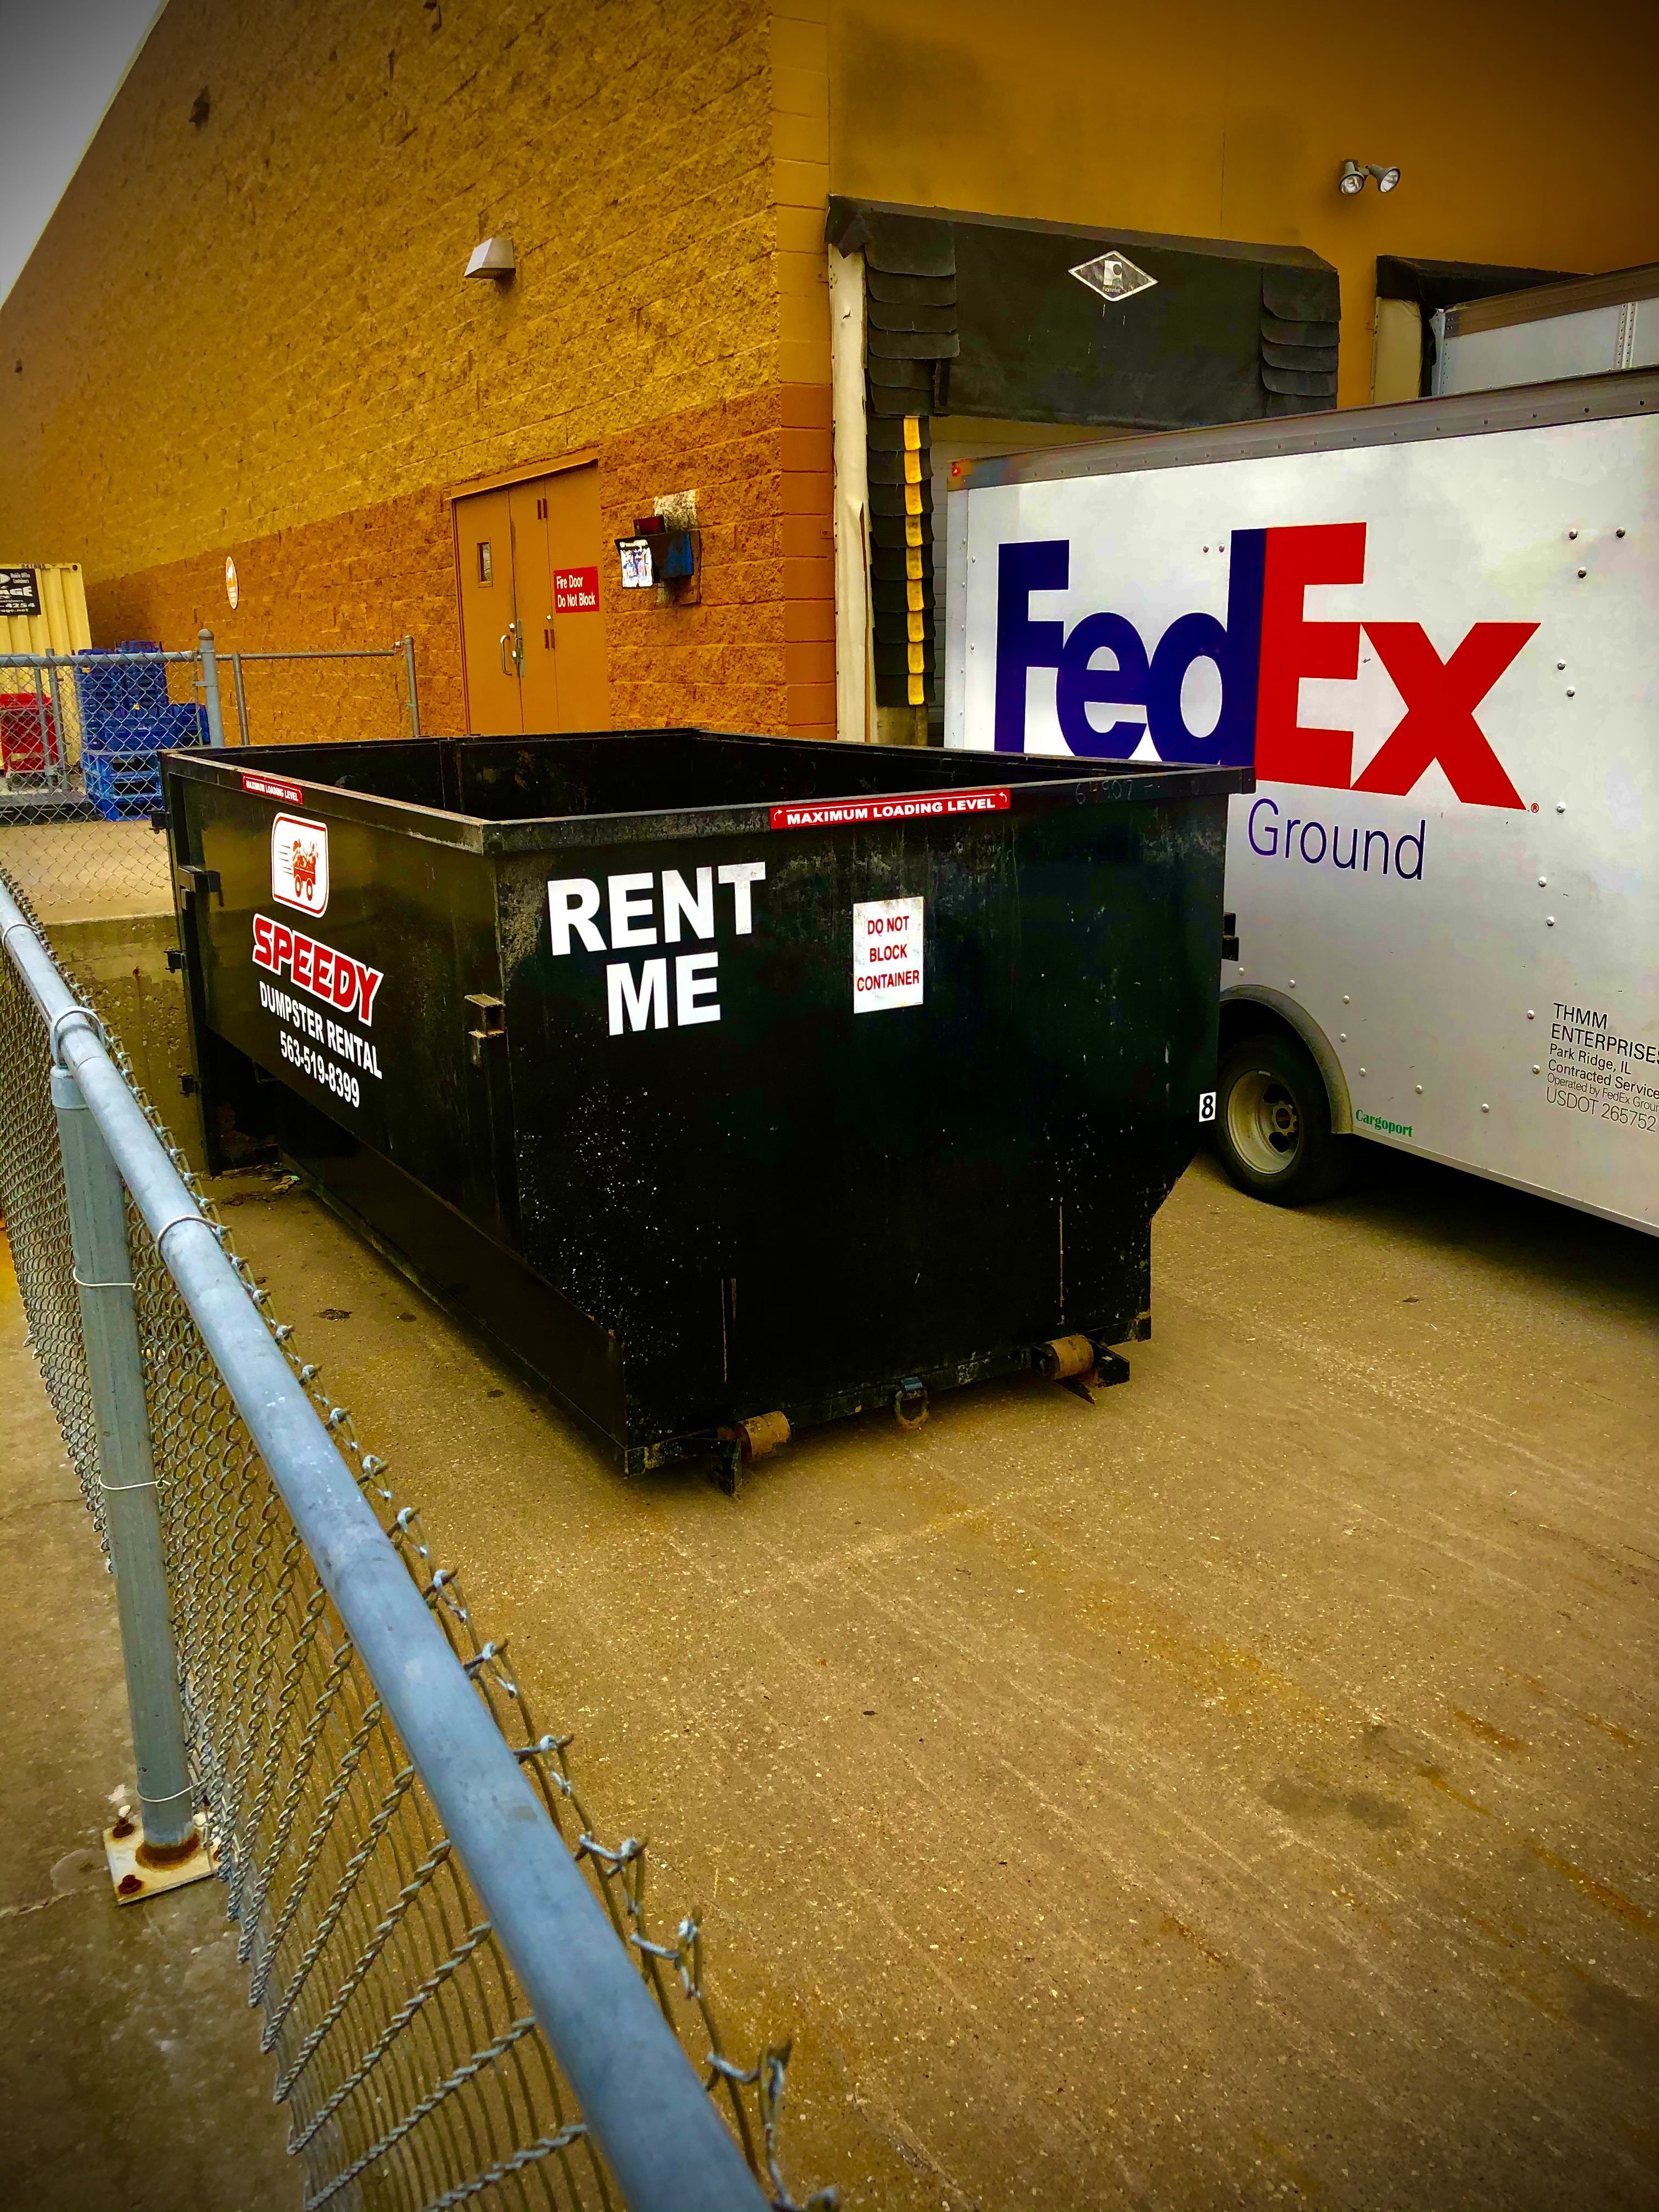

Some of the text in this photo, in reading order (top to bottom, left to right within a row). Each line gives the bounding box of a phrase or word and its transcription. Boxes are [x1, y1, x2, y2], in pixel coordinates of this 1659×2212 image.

[556, 574, 583, 589] Fire Door
[557, 591, 596, 608] Do Not Block
[994, 522, 1541, 811] FedEx
[246, 780, 299, 802] MAXIMUM LOADING LEVEL
[787, 798, 996, 825] MAXIMUM LOADING LEVEL
[1247, 798, 1426, 881] Ground
[547, 861, 766, 956] RENT
[867, 915, 910, 935] DO NOT
[870, 943, 908, 963] BLOCK
[252, 913, 384, 1027] SPEEDY
[856, 969, 920, 992] CONTAINER
[606, 951, 721, 1036] ME
[259, 980, 383, 1080] DUMPSTER RENTAL
[1553, 1002, 1608, 1030] THMM
[1549, 1042, 1632, 1075] Park Ridge, IL
[1551, 1023, 1659, 1065] ENTERPRISE
[280, 1030, 360, 1108] 563-519-8399
[1548, 1058, 1659, 1100] Contracted Service
[1547, 1072, 1588, 1093] Operated
[1589, 1084, 1600, 1098] by
[1601, 1087, 1630, 1105] FedEx
[1201, 1095, 1214, 1119] 8
[1355, 1109, 1413, 1138] Cargoport
[1546, 1086, 1657, 1132] USDOT 265752
